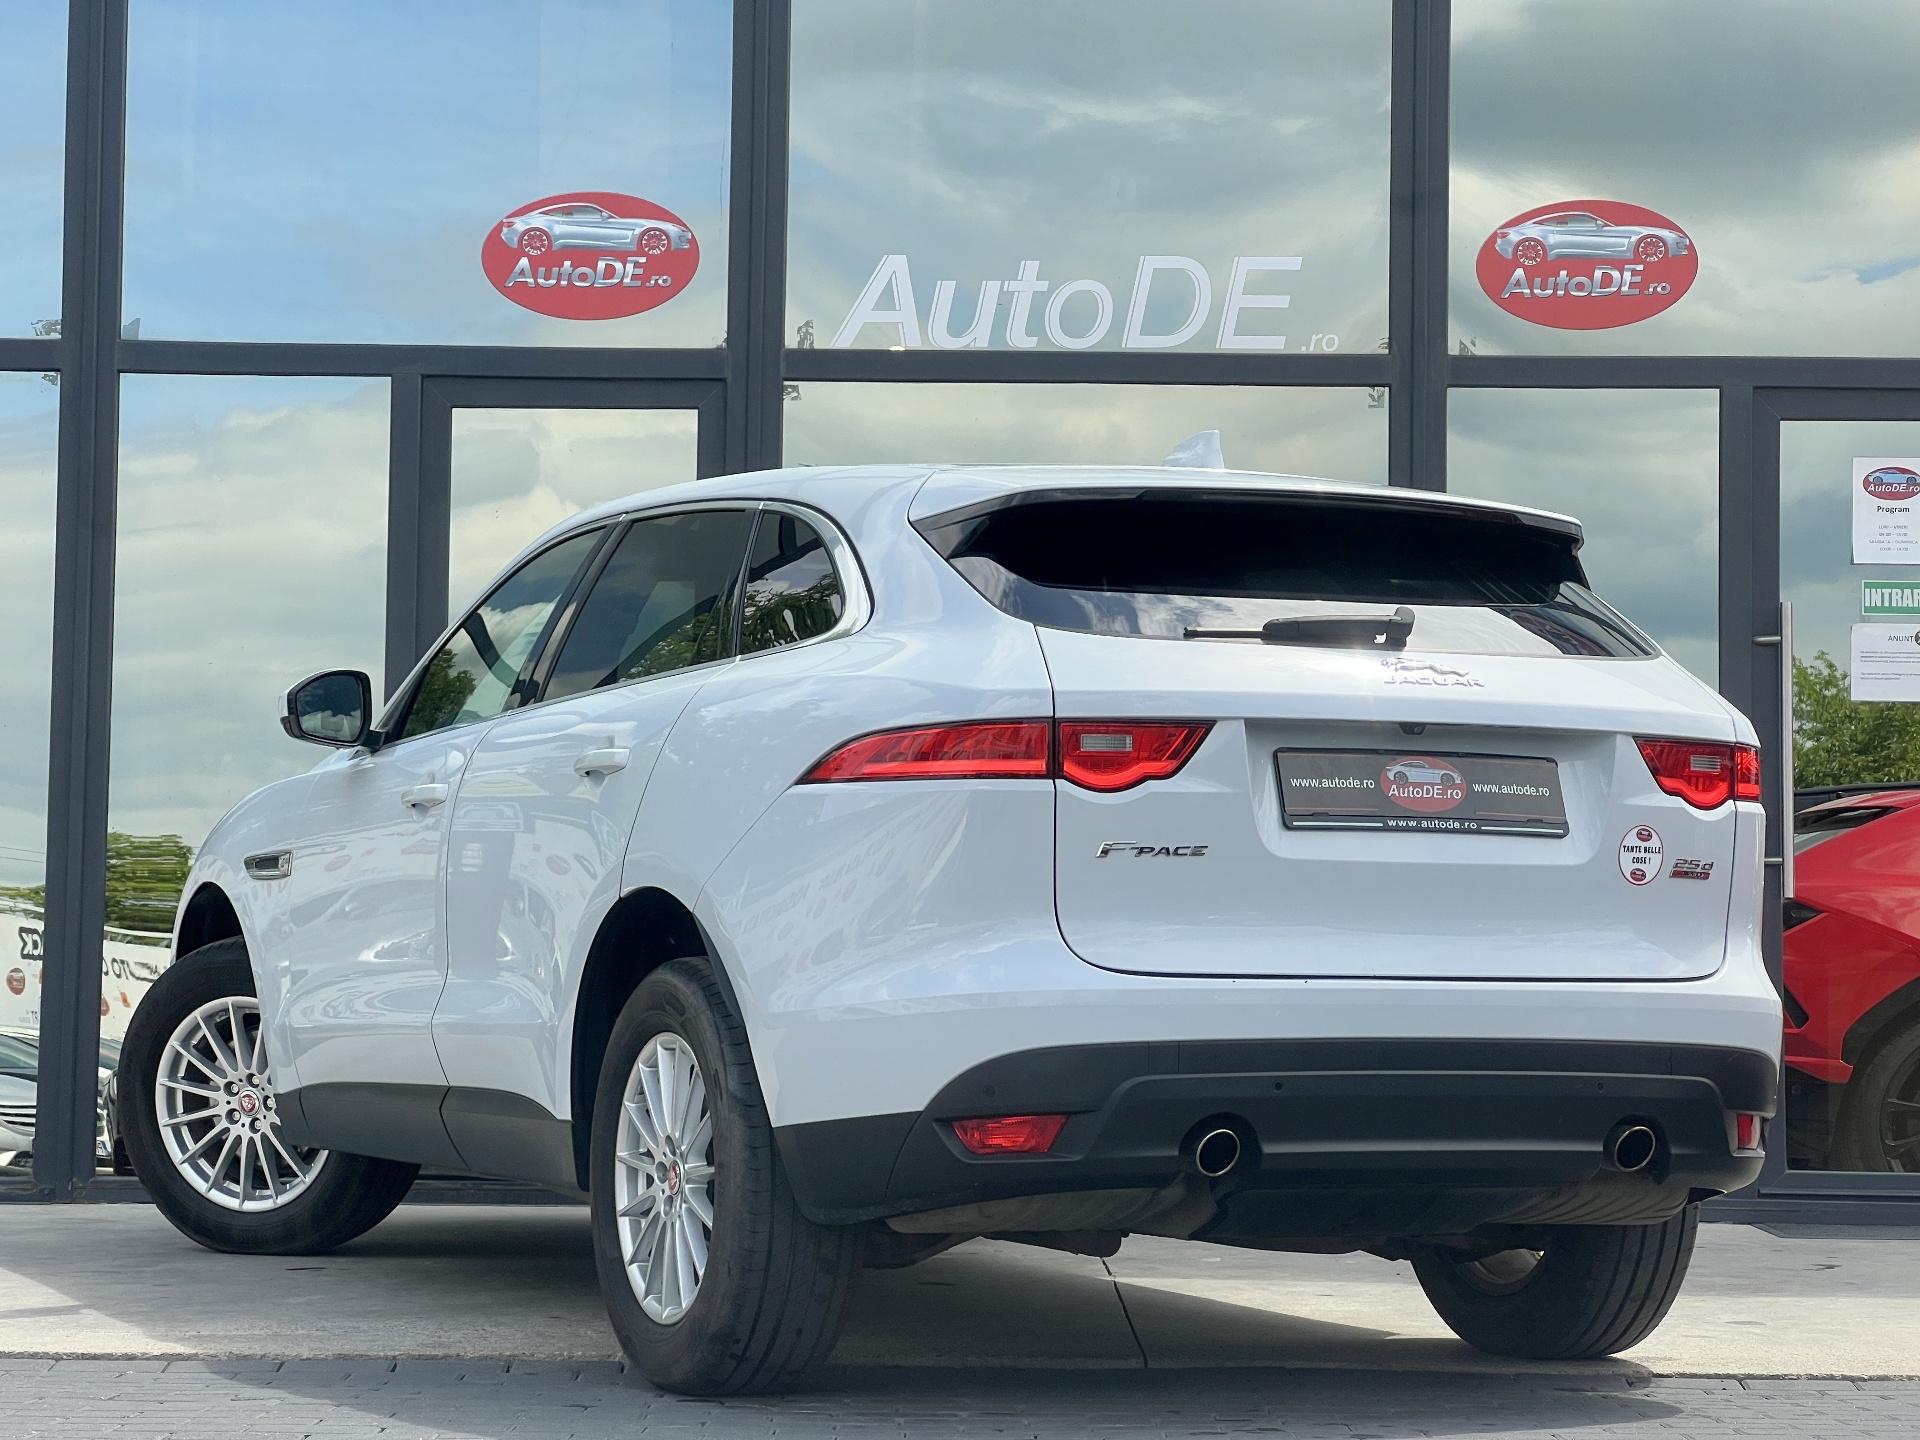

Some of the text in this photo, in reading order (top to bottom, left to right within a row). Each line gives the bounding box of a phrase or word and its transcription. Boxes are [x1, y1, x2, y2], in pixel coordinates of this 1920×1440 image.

[1867, 483, 1920, 492] AutoDE.ro
[1876, 505, 1910, 514] Program
[1290, 776, 1375, 789] www.autode.ro
[1388, 784, 1462, 799] AutoDE.ro
[1472, 782, 1550, 797] www.autode.ro
[1387, 818, 1478, 830] www.autode.ro
[1623, 844, 1661, 855] TANTE BELLE
[1632, 856, 1647, 865] COSE
[1673, 858, 1714, 871] 25d
